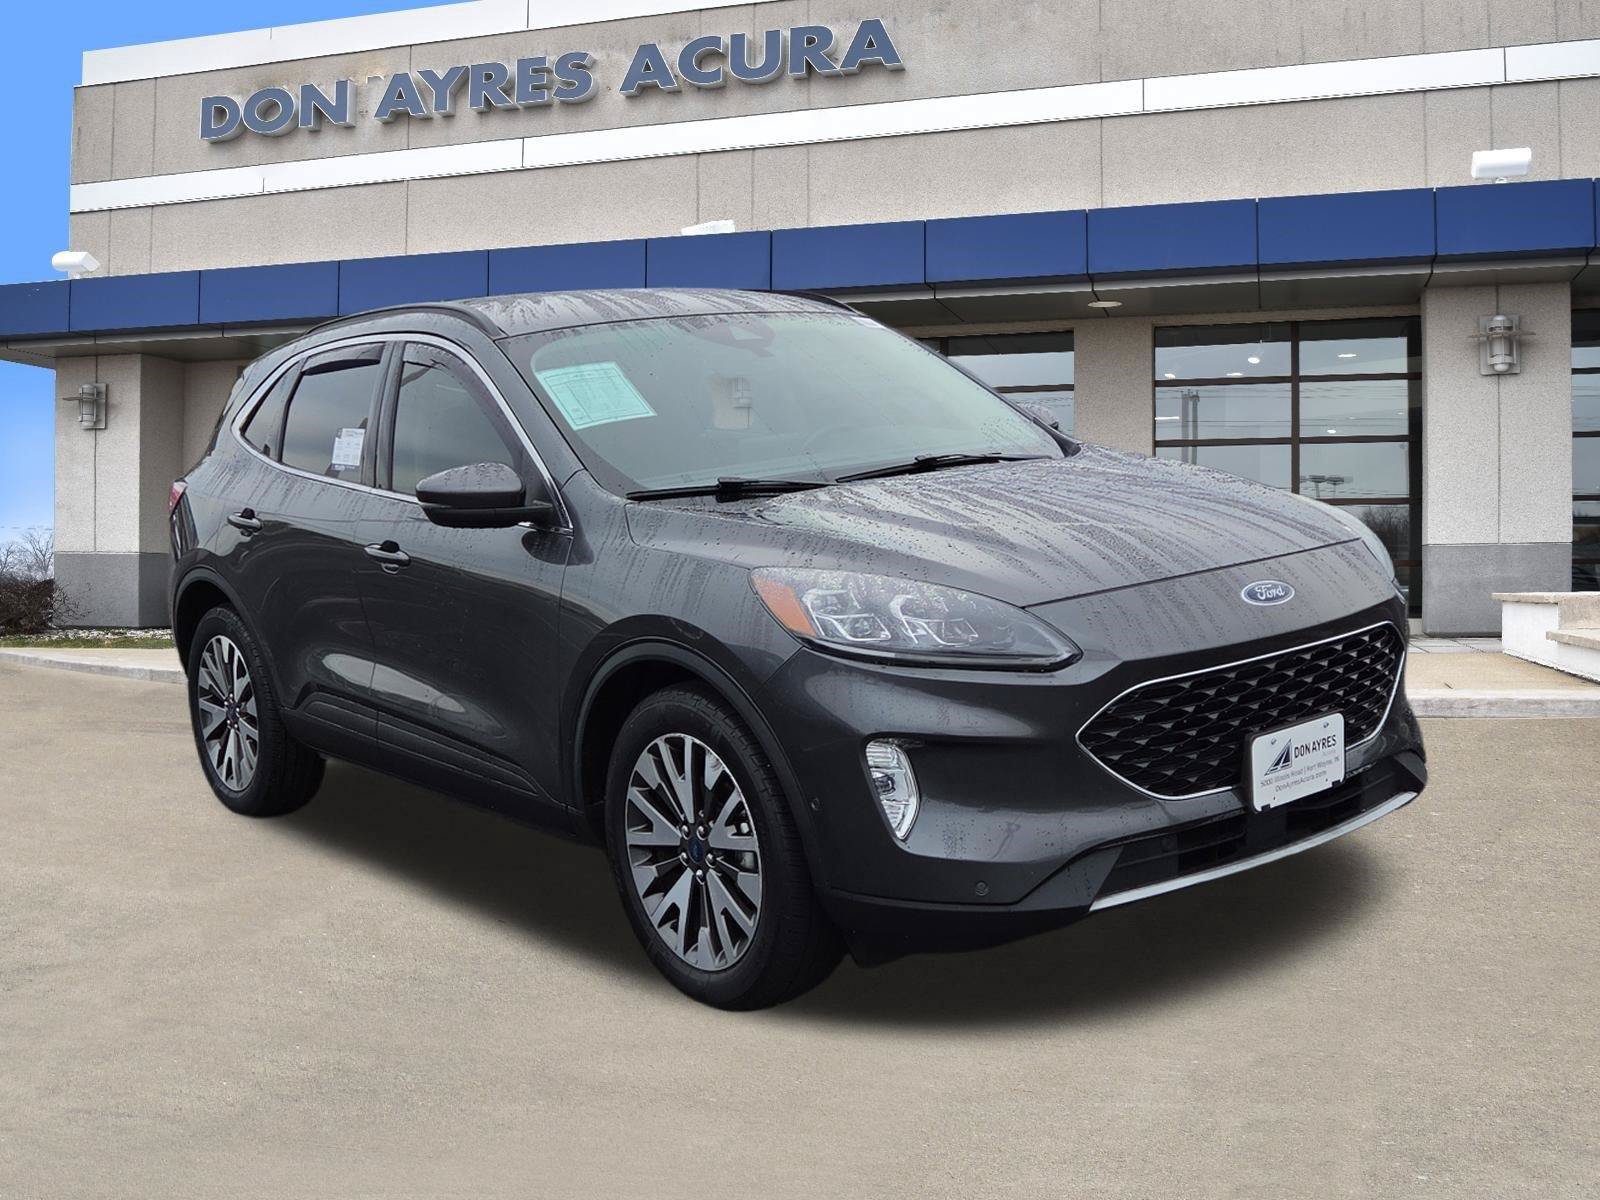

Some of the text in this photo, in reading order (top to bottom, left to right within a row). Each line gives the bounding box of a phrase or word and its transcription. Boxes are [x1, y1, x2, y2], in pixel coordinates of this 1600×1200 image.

[200, 18, 904, 142] DON AYRES ACURA
[1255, 584, 1286, 600] Ford
